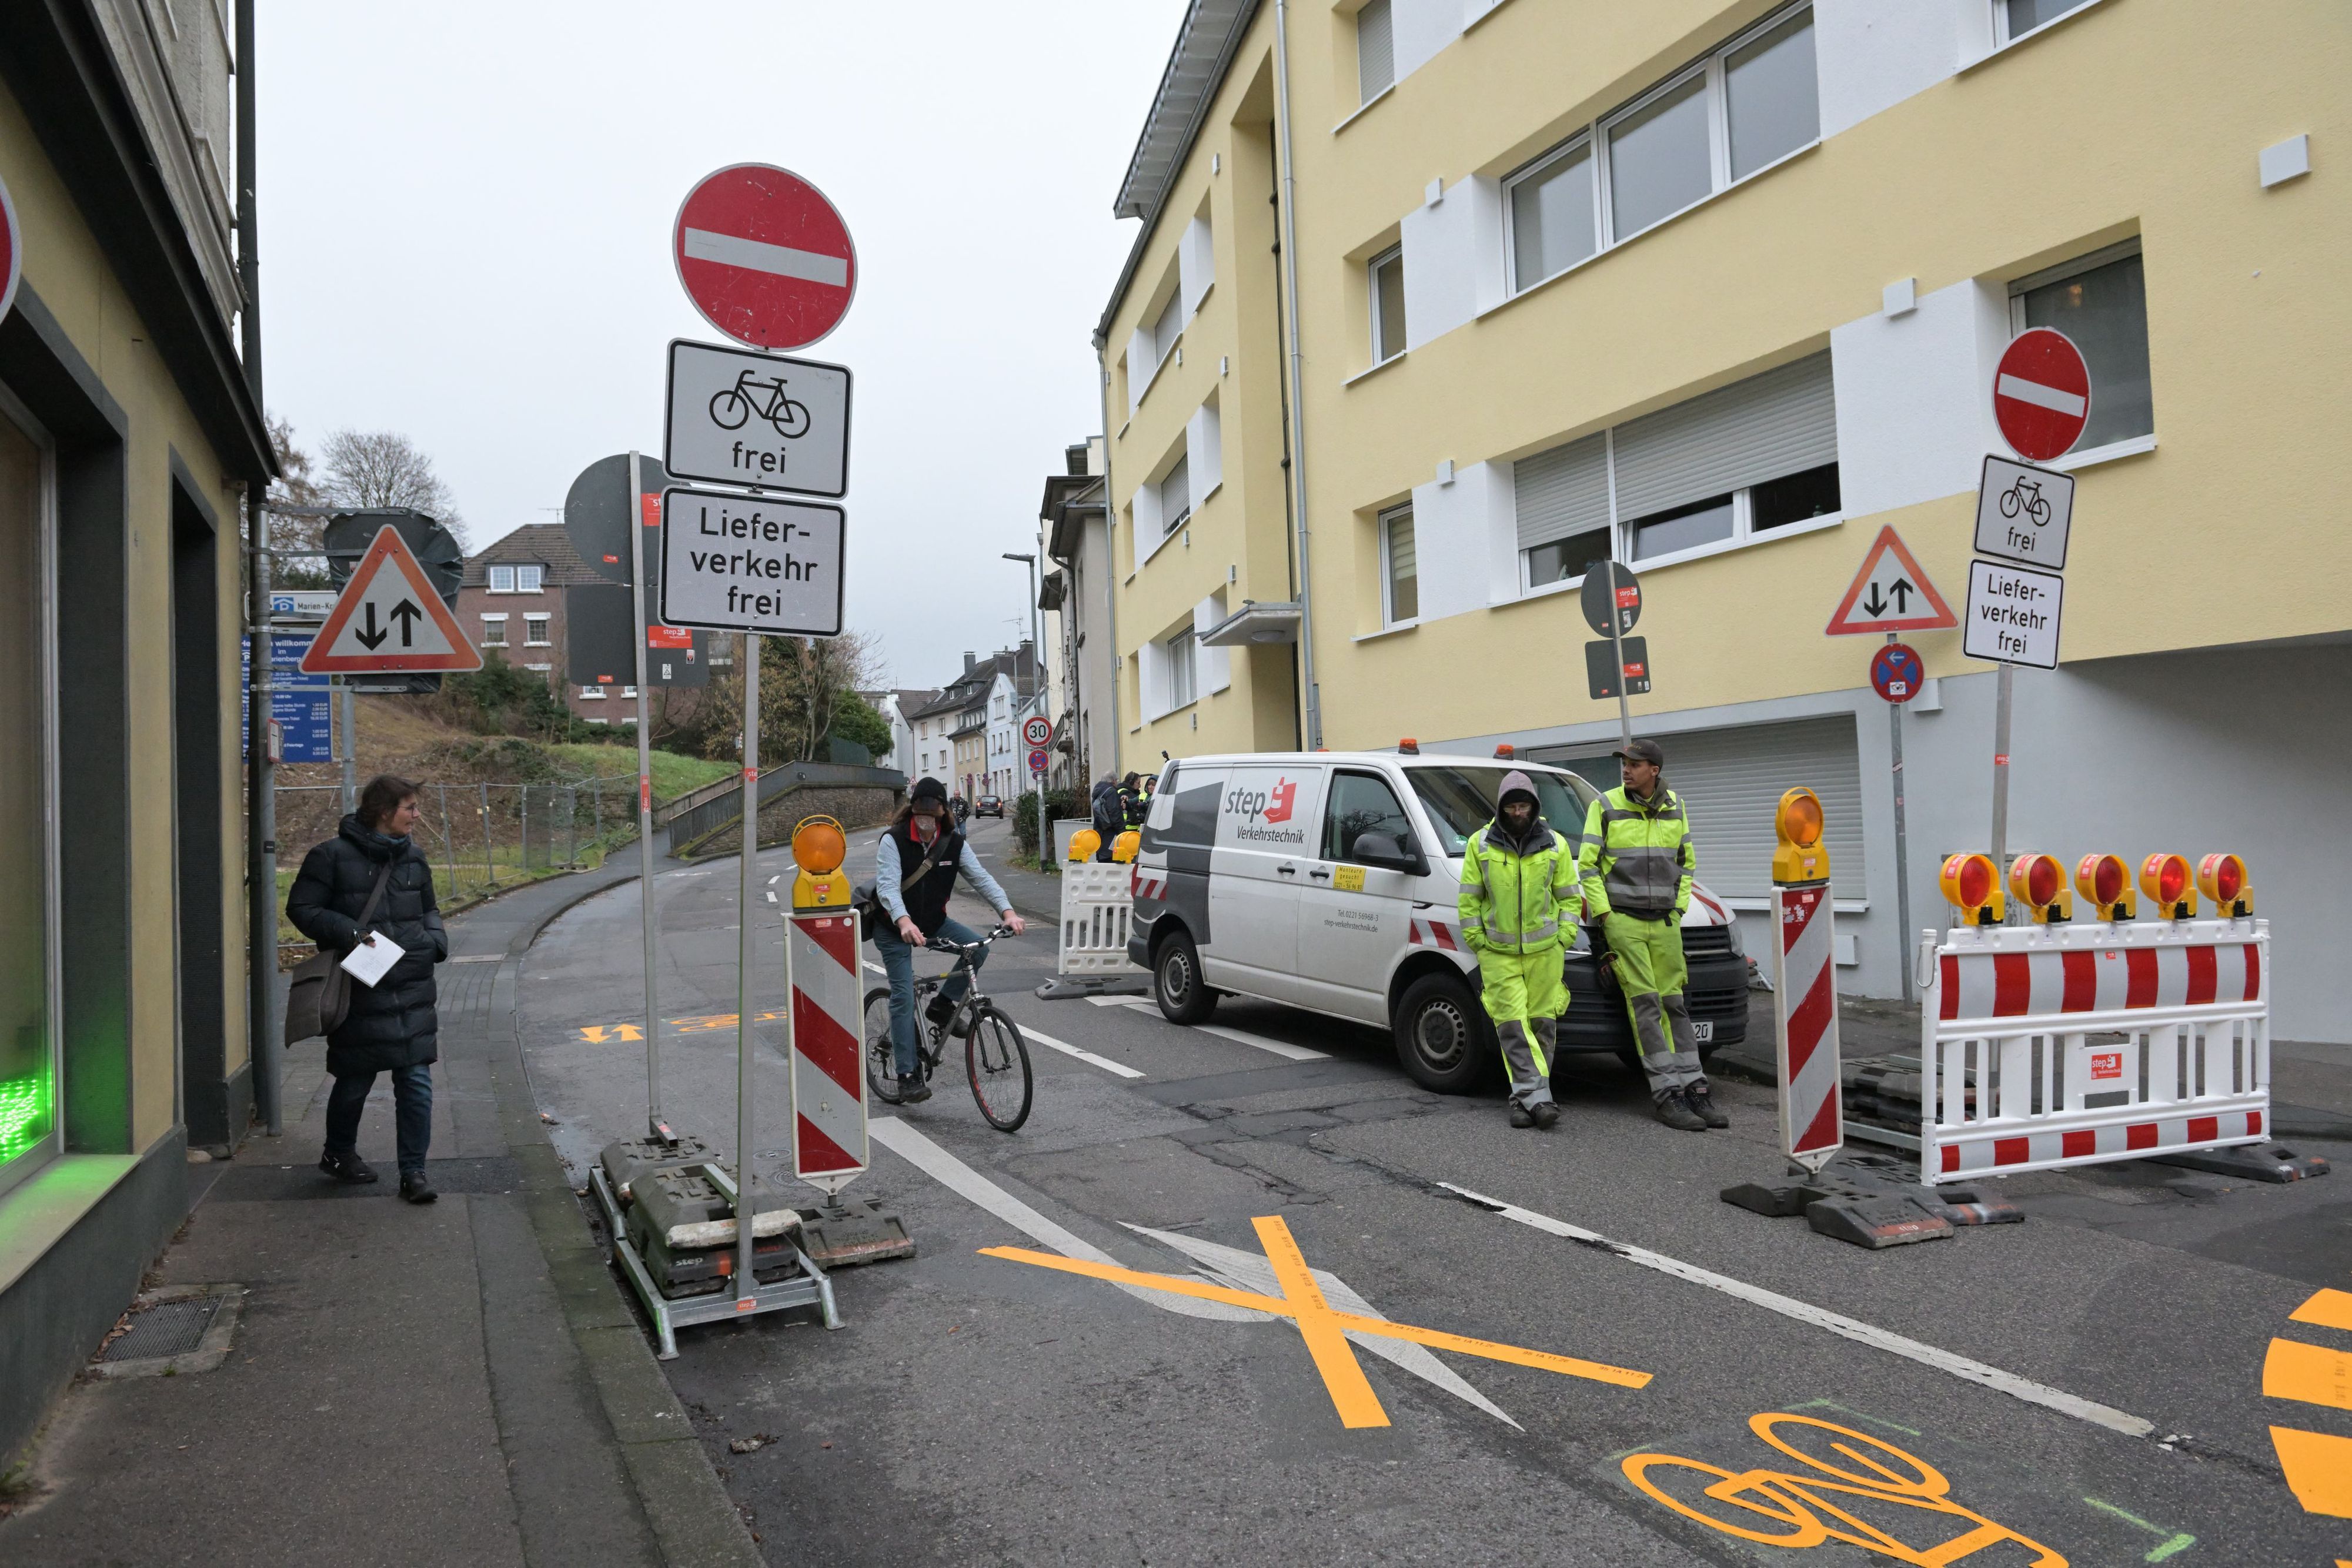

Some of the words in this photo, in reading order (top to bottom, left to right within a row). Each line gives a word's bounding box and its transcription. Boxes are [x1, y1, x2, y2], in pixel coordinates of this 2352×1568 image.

[731, 441, 786, 474] frei
[700, 507, 810, 543] Liefer-
[2007, 527, 2036, 552] frei
[690, 549, 818, 582] verkehr
[1987, 573, 2046, 602] Liefer-
[727, 586, 781, 616] frei
[1981, 603, 2047, 631] verkehr
[1998, 630, 2027, 654] frei
[1030, 724, 1047, 739] 30
[1225, 787, 1266, 823] step
[1237, 825, 1304, 844] Verkehrstechnik
[1324, 919, 1378, 932] step-verkehrstechnik.de
[1358, 912, 1378, 921] 56968-3
[1695, 1024, 1708, 1038] 20
[2092, 1058, 2107, 1069] step
[676, 1257, 704, 1266] step
